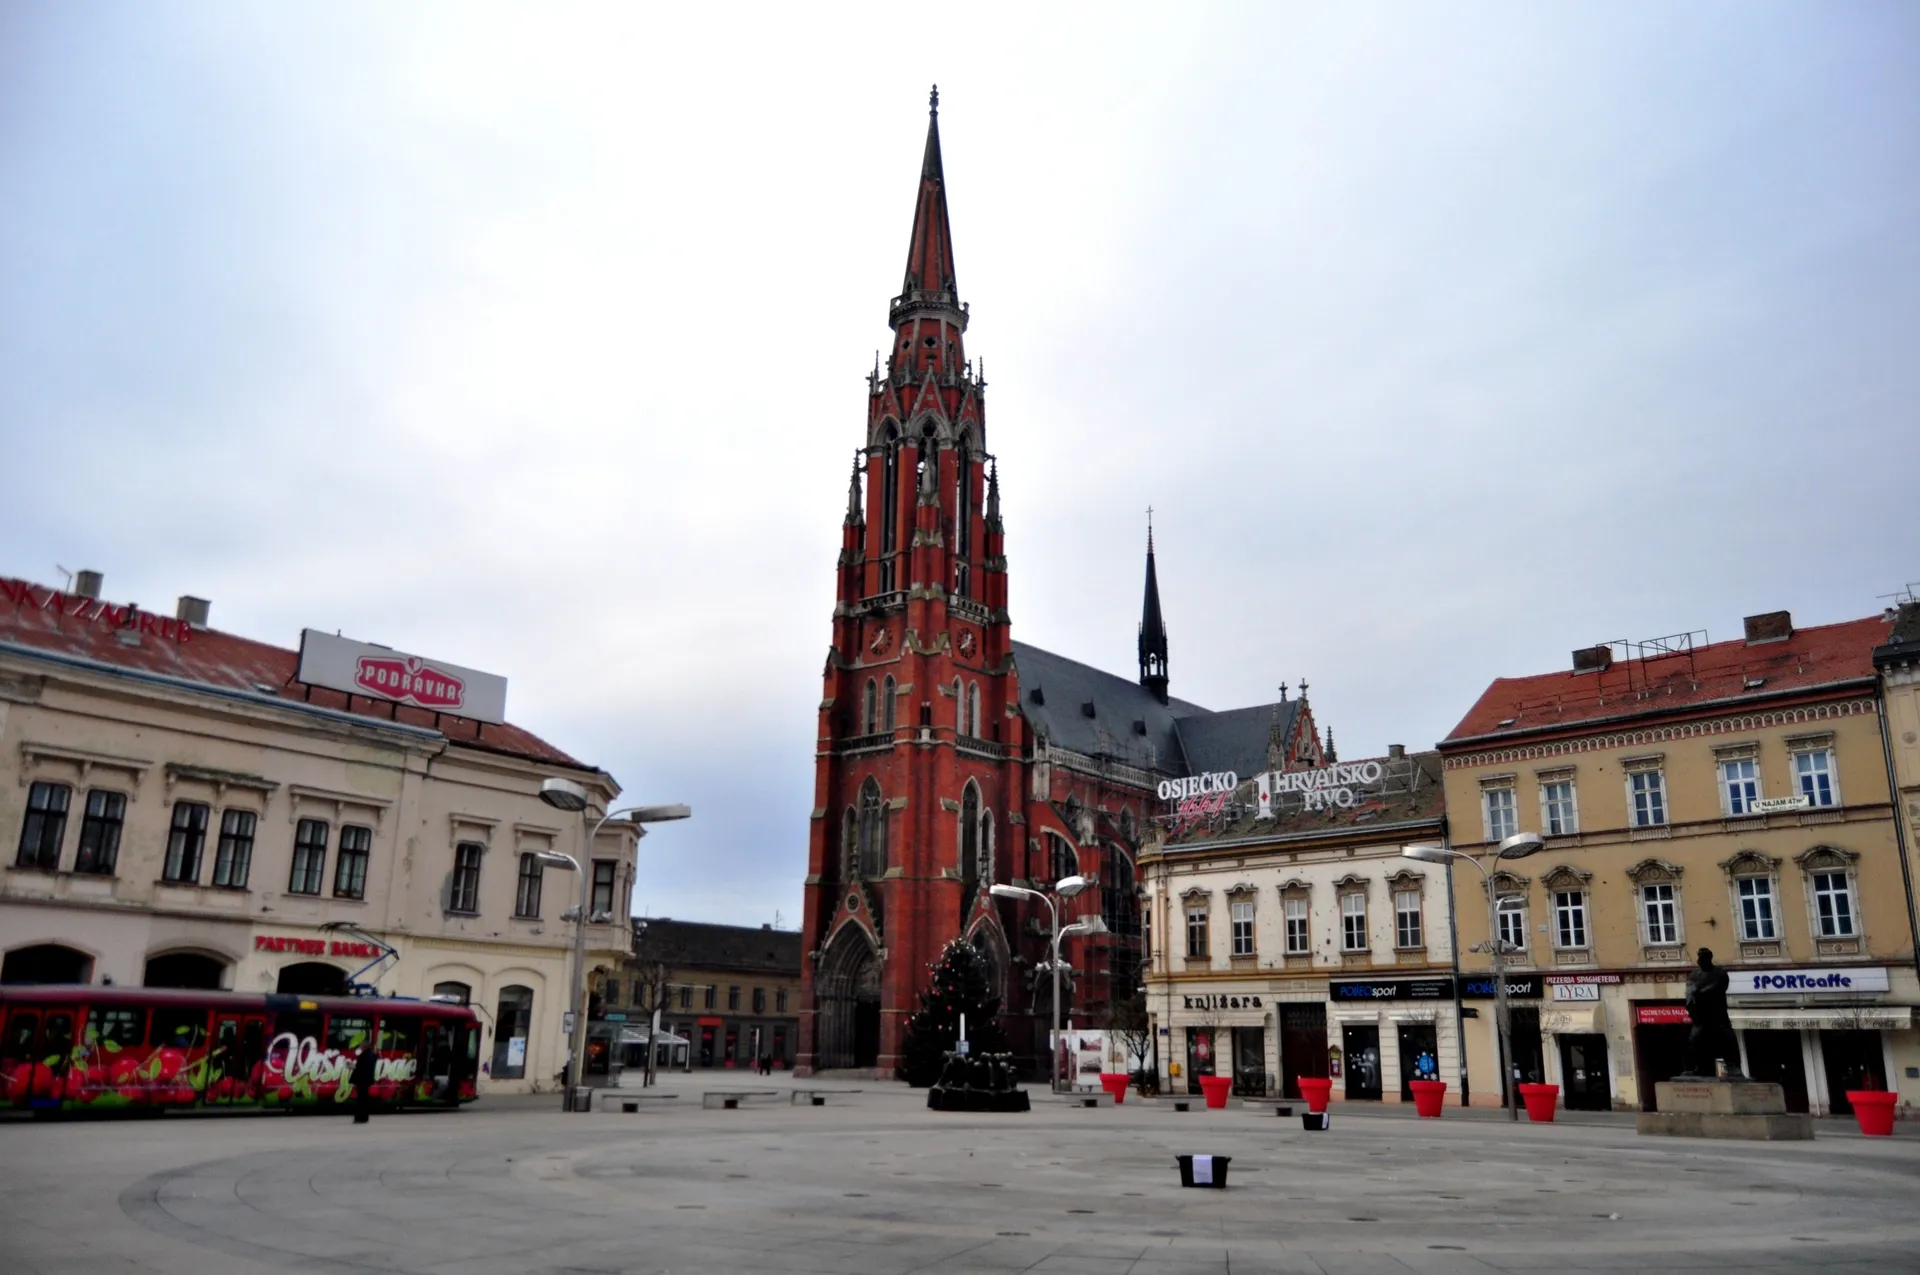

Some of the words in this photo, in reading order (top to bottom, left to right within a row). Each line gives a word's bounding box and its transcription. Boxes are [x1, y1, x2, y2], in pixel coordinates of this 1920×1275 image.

[364, 665, 457, 700] PODRAVKA
[1157, 770, 1238, 800] OSJEČKO
[1274, 761, 1381, 794] HRVATSKO
[1303, 786, 1354, 812] PIVO
[1762, 799, 1787, 807] NAJAM
[255, 935, 326, 956] PARTNER
[331, 941, 381, 958] BANKA
[1546, 976, 1575, 985] PIZZERIA
[1576, 975, 1621, 984] SPAGHETERIA
[1753, 973, 1852, 990] SPORTcaffe
[1559, 985, 1595, 999] LYRA
[1183, 994, 1263, 1011] knjižara
